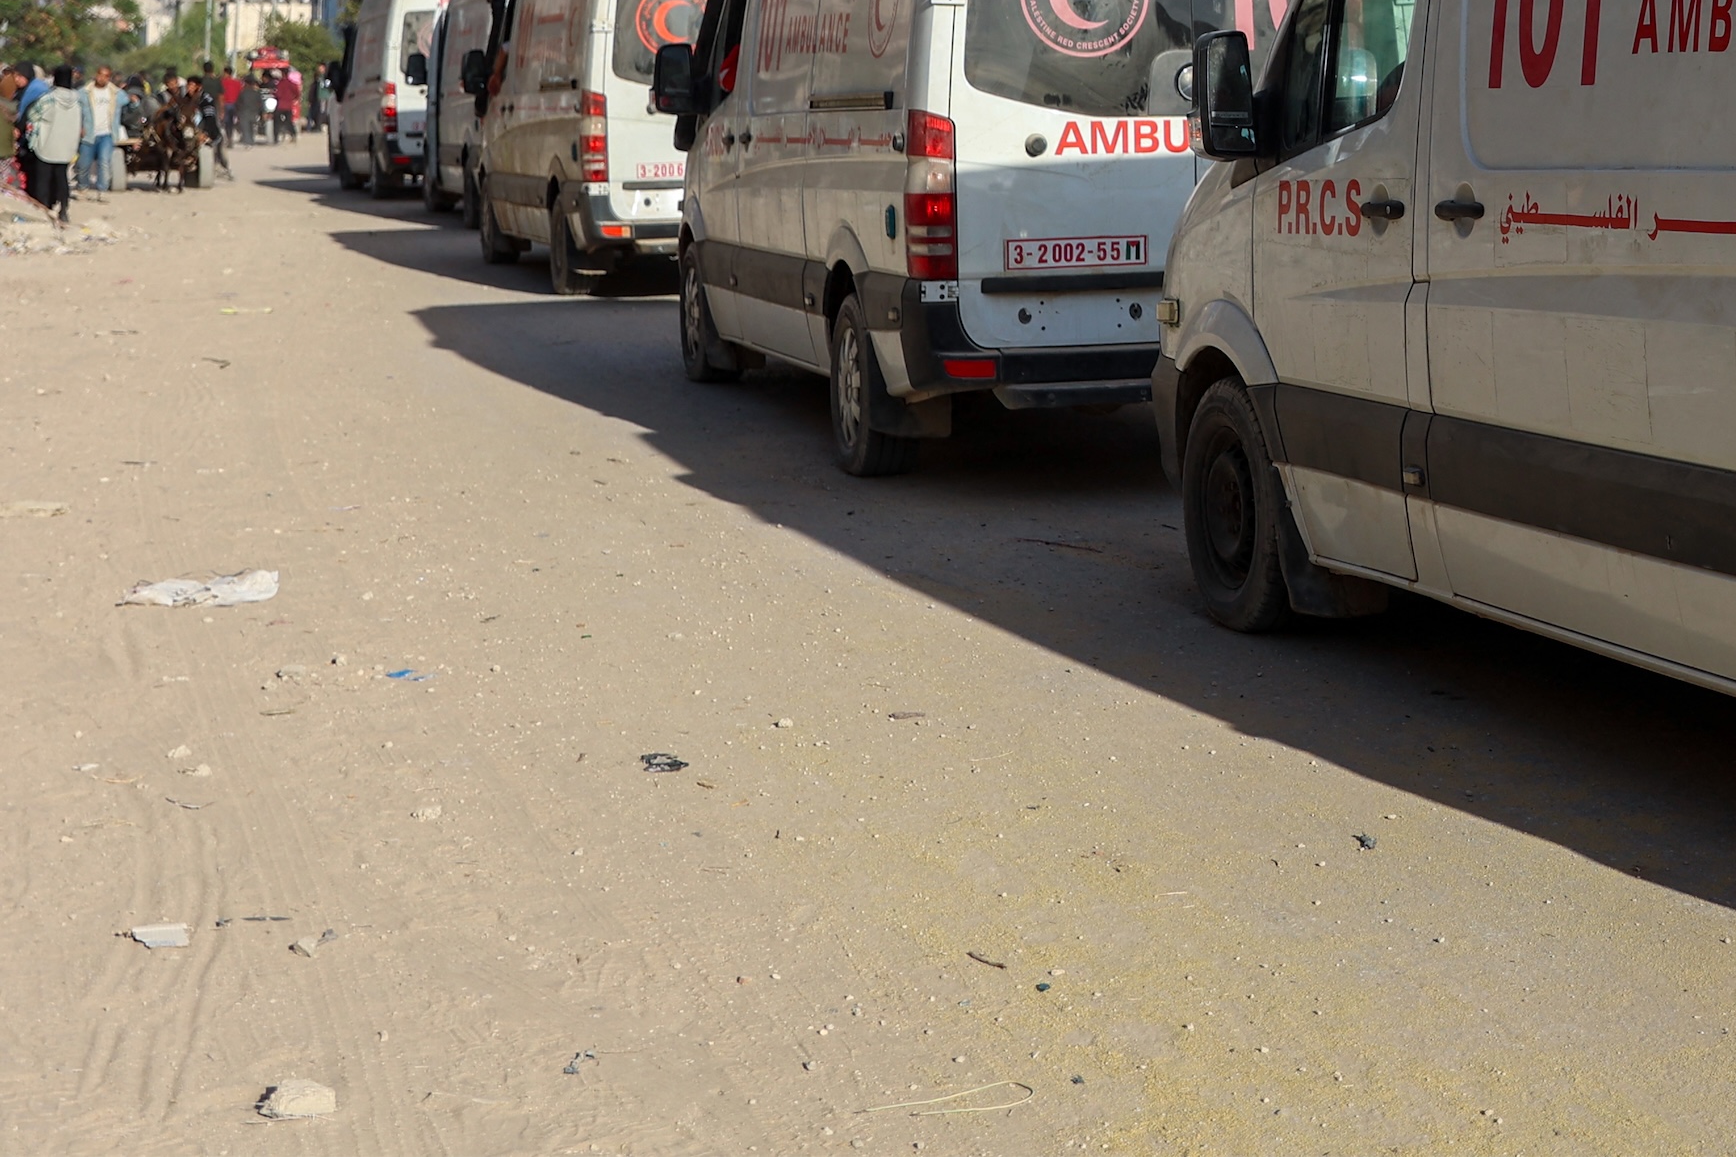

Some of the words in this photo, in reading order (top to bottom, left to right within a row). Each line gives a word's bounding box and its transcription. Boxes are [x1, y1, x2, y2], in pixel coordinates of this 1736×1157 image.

[785, 12, 850, 54] AMBULANCE
[1057, 35, 1074, 48] RED
[1076, 33, 1119, 50] CRESCENT
[1277, 179, 1361, 237] P.R.C.S
[1498, 191, 1639, 244] الفلسطيني
[1014, 240, 1122, 264] 3-2002-55
